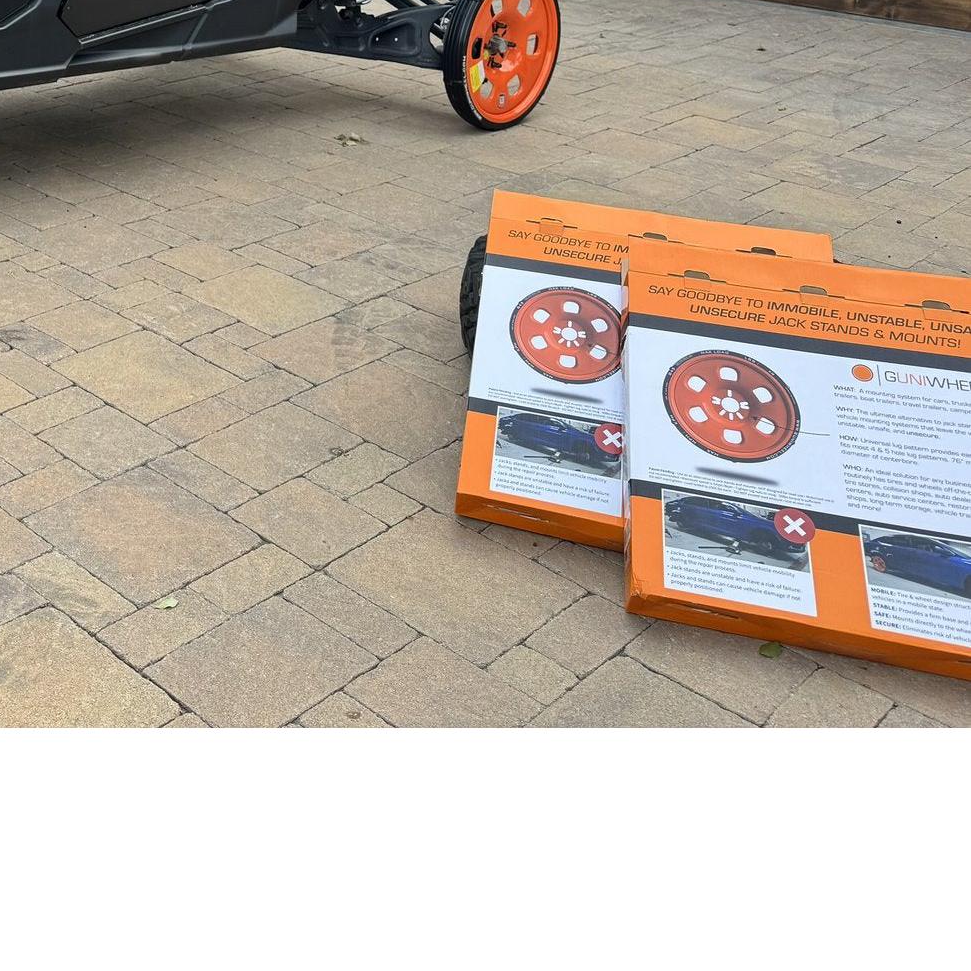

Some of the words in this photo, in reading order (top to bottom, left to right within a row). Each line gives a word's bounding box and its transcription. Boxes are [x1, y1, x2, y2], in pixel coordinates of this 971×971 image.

[508, 229, 531, 240] SAY
[533, 233, 592, 249] GOODBYE
[596, 241, 610, 251] TO
[543, 246, 611, 264] UNSECURE
[648, 284, 674, 297] SAY
[677, 288, 742, 306] GOODBYE
[746, 297, 763, 309] TO
[767, 300, 841, 320] IMMOBILE,
[847, 311, 925, 331] UNSTABLE,
[690, 304, 766, 323] UNSECURE
[769, 314, 807, 329] JACK
[810, 320, 869, 337] STANDS
[873, 328, 885, 339] &
[890, 330, 961, 349] MOUNTS!
[884, 371, 971, 391] GUNIWHE
